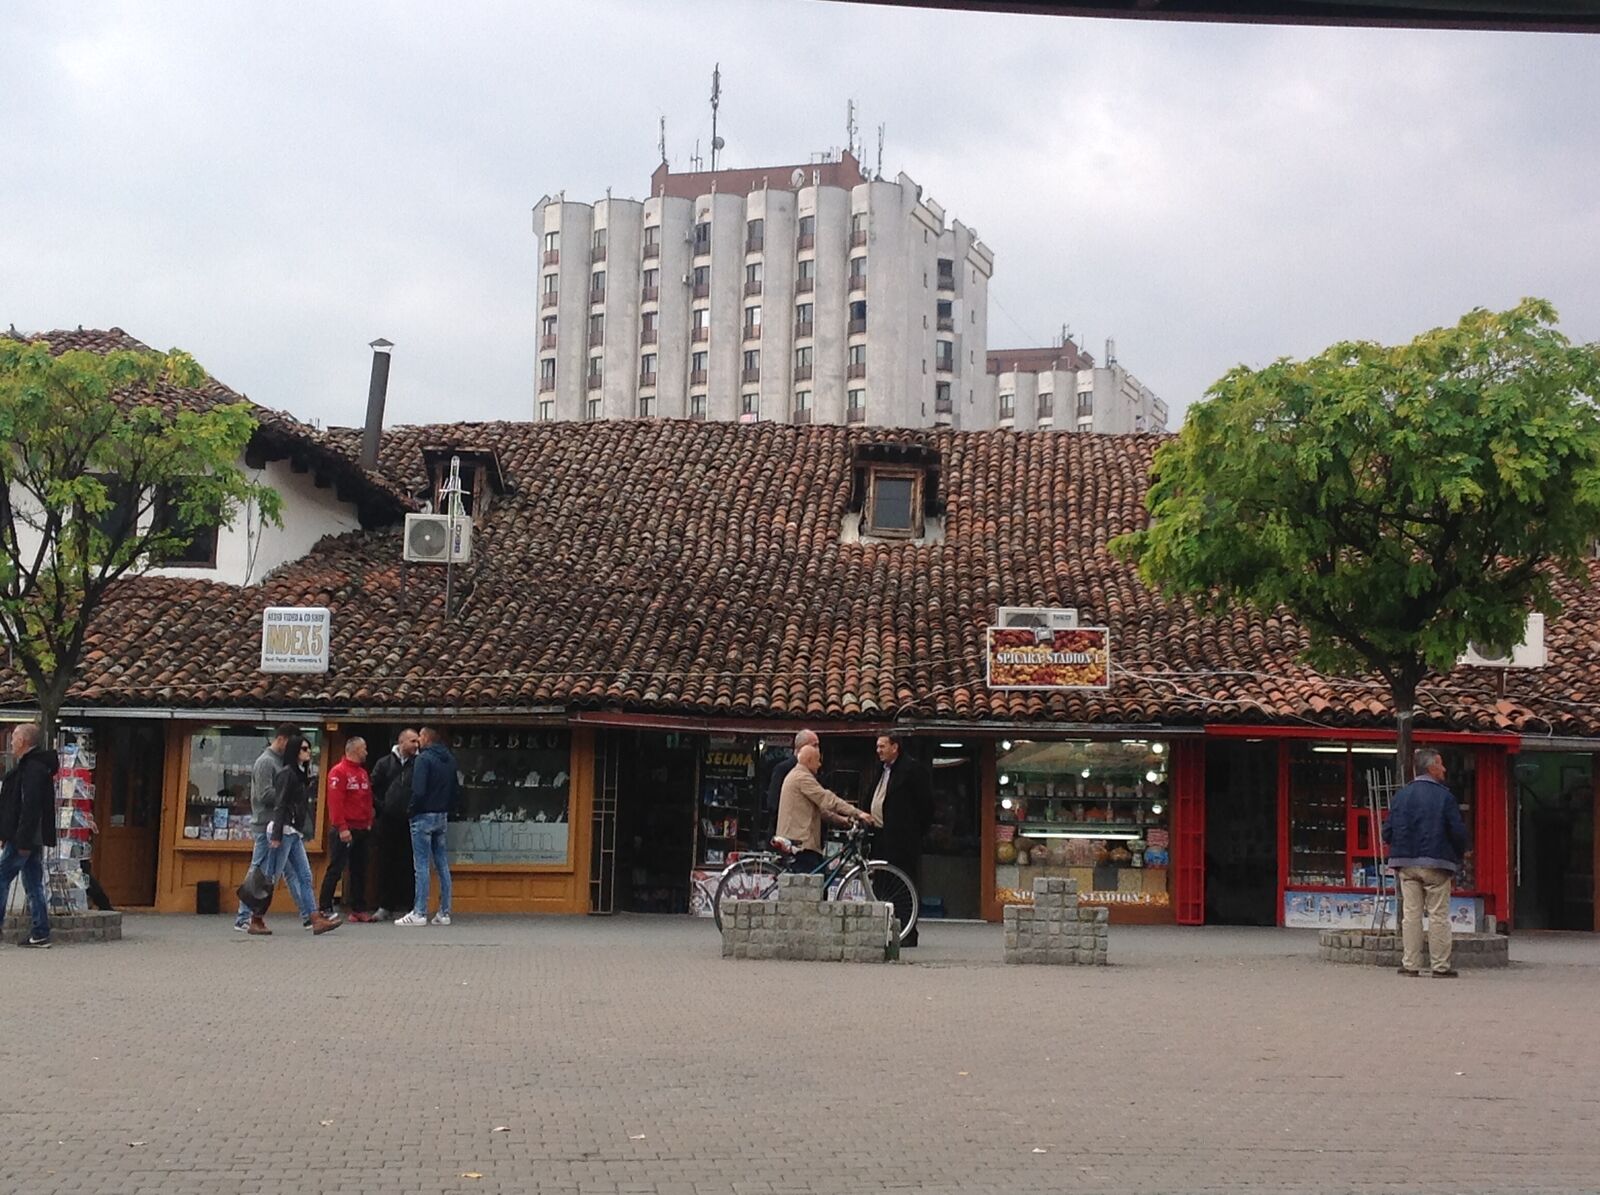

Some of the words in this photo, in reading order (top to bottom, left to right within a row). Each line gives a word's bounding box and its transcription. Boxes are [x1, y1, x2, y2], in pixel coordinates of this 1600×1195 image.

[284, 613, 298, 621] VIDEO
[266, 625, 311, 655] INDEX
[311, 625, 323, 655] 5
[1046, 652, 1091, 664] STADION
[706, 752, 753, 767] SELMA
